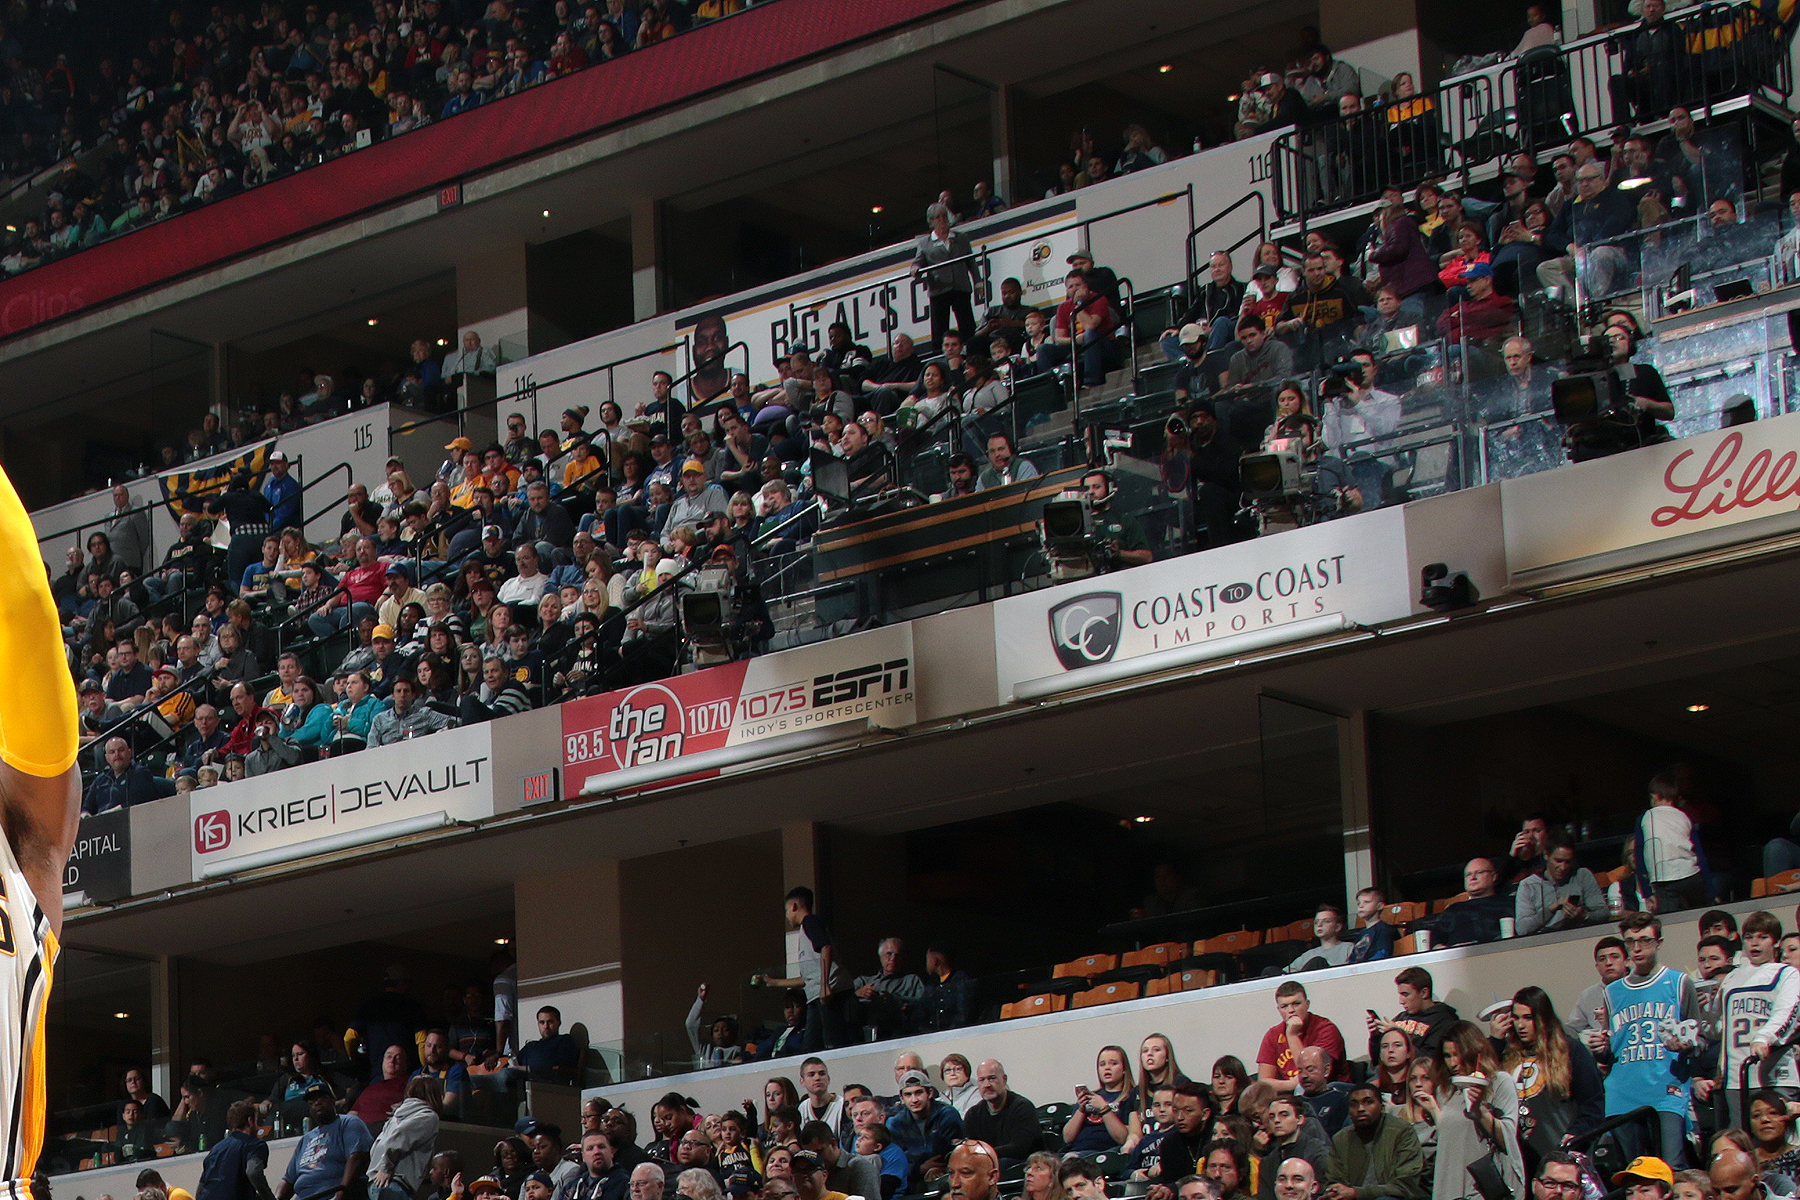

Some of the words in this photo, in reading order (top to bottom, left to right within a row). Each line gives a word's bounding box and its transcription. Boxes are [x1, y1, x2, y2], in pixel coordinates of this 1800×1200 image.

[442, 186, 458, 206] EXIT
[354, 423, 372, 452] 115
[1650, 431, 1800, 527] Lill
[1133, 584, 1218, 631] COAST
[1227, 586, 1245, 600] TO
[1255, 555, 1346, 602] COAST
[1152, 596, 1325, 649] IMPORTS
[740, 685, 807, 721] 107.5
[812, 658, 910, 709] ESPN
[608, 702, 666, 741] the
[688, 700, 732, 737] 1070
[740, 719, 788, 740] INDY'S
[794, 692, 914, 727] SPORTSCENTER
[567, 730, 604, 763] 93.5
[624, 731, 685, 768] fan
[238, 794, 329, 837] KRIEG
[340, 757, 488, 815] DEVAULT
[523, 774, 549, 802] EXIT
[67, 833, 121, 862] APITAL
[1612, 1002, 1676, 1032] INDIANA
[1732, 998, 1772, 1017] PACERS
[1627, 1020, 1657, 1045] 33
[1621, 1043, 1666, 1065] STATE
